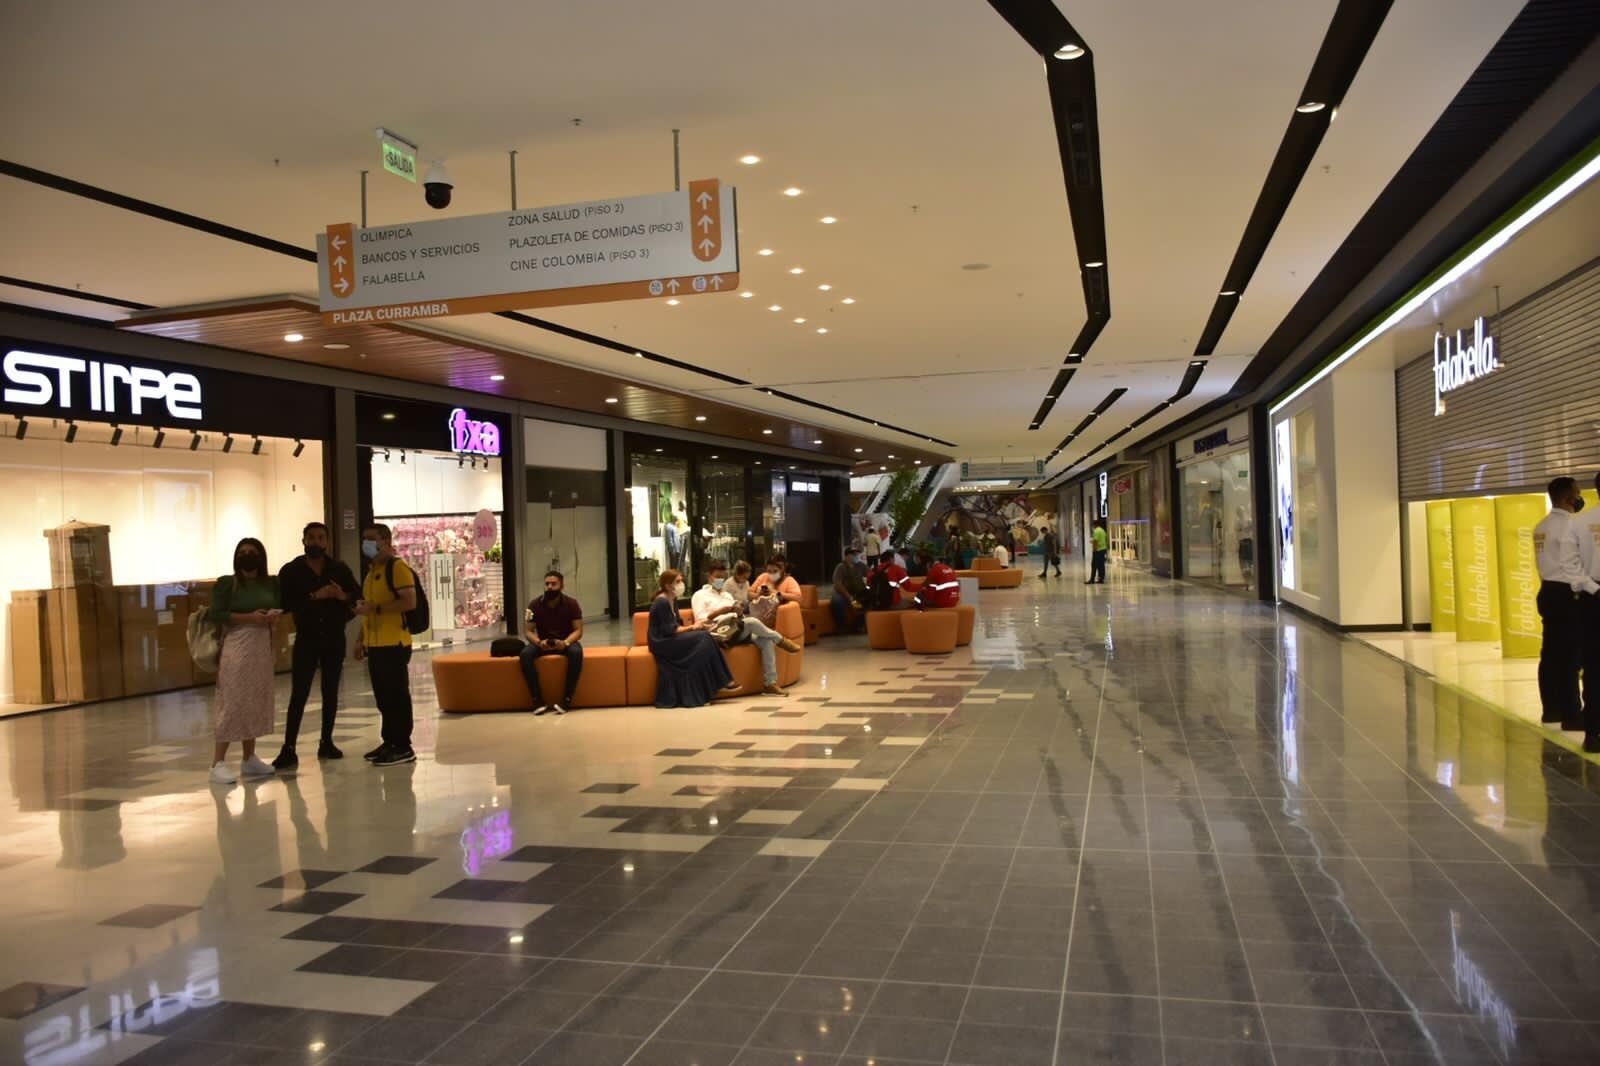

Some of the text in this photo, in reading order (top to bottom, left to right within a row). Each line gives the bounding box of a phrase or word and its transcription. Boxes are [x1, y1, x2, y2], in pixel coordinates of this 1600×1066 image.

[508, 215, 539, 227] ZONA
[543, 208, 580, 222] SALUD
[584, 204, 612, 217] (PISO
[360, 228, 413, 242] OLIMPICA
[509, 232, 572, 248] PLAZOLETA
[574, 230, 589, 242] DE
[592, 224, 645, 239] COMIDAS
[648, 223, 672, 234] (PISO
[361, 242, 480, 264] BANCOS Y SERVICIOS
[510, 258, 538, 271] CINE
[542, 252, 606, 268] COLOMBIA
[609, 249, 636, 263] (PISO
[362, 270, 425, 285] FALABELLA
[333, 303, 449, 324] PLAZA CURRAMBA
[449, 408, 500, 455] fxa
